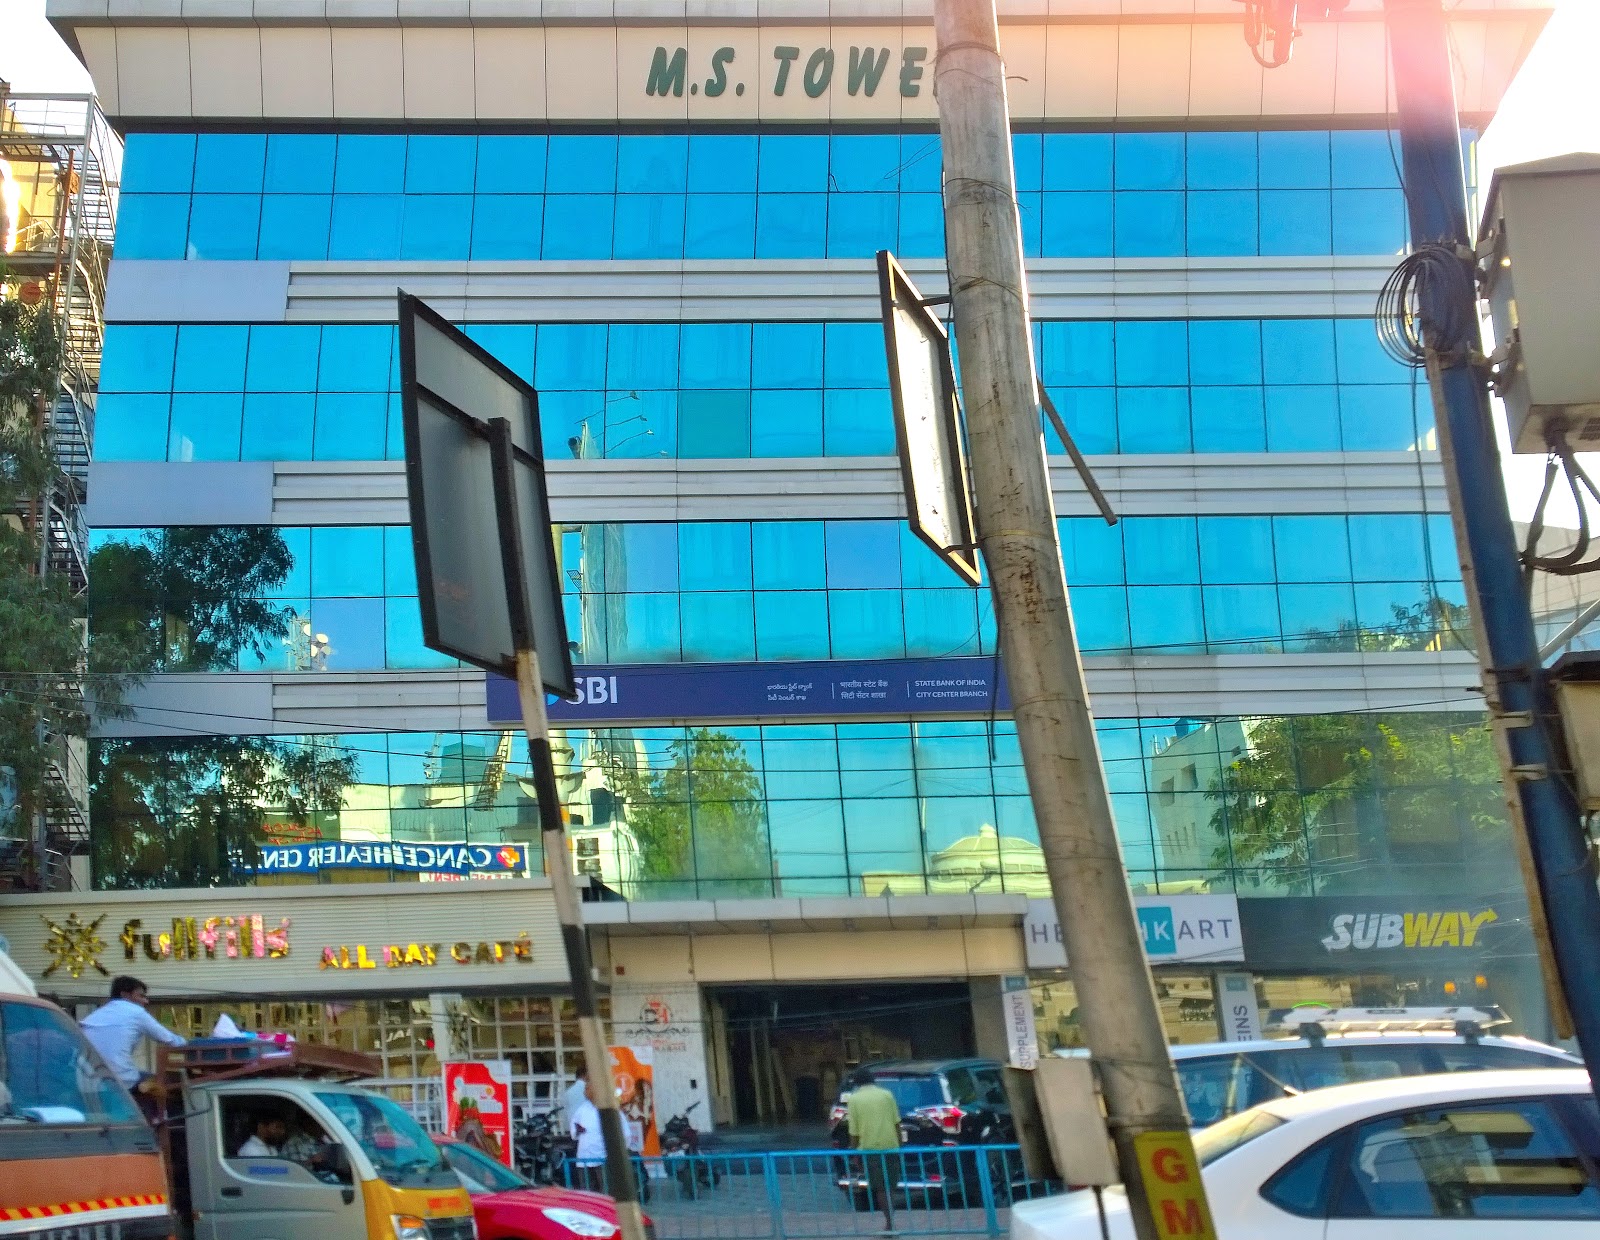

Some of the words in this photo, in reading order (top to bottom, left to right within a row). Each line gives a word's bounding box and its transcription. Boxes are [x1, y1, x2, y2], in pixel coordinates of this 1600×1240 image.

[646, 46, 744, 97] M.S.
[773, 45, 937, 98] TOWE
[564, 676, 618, 705] SBI
[840, 680, 861, 688] भारतीय
[863, 680, 877, 688] स्टेट
[841, 691, 855, 699] सिटी
[870, 691, 886, 699] शाखा
[932, 690, 959, 698] CENTER
[960, 689, 988, 697] BRANCH
[1321, 908, 1498, 951] SUBWAY
[319, 944, 376, 970] ALL
[383, 942, 441, 967] DAY
[1012, 994, 1032, 1069] SUPPLEMENT
